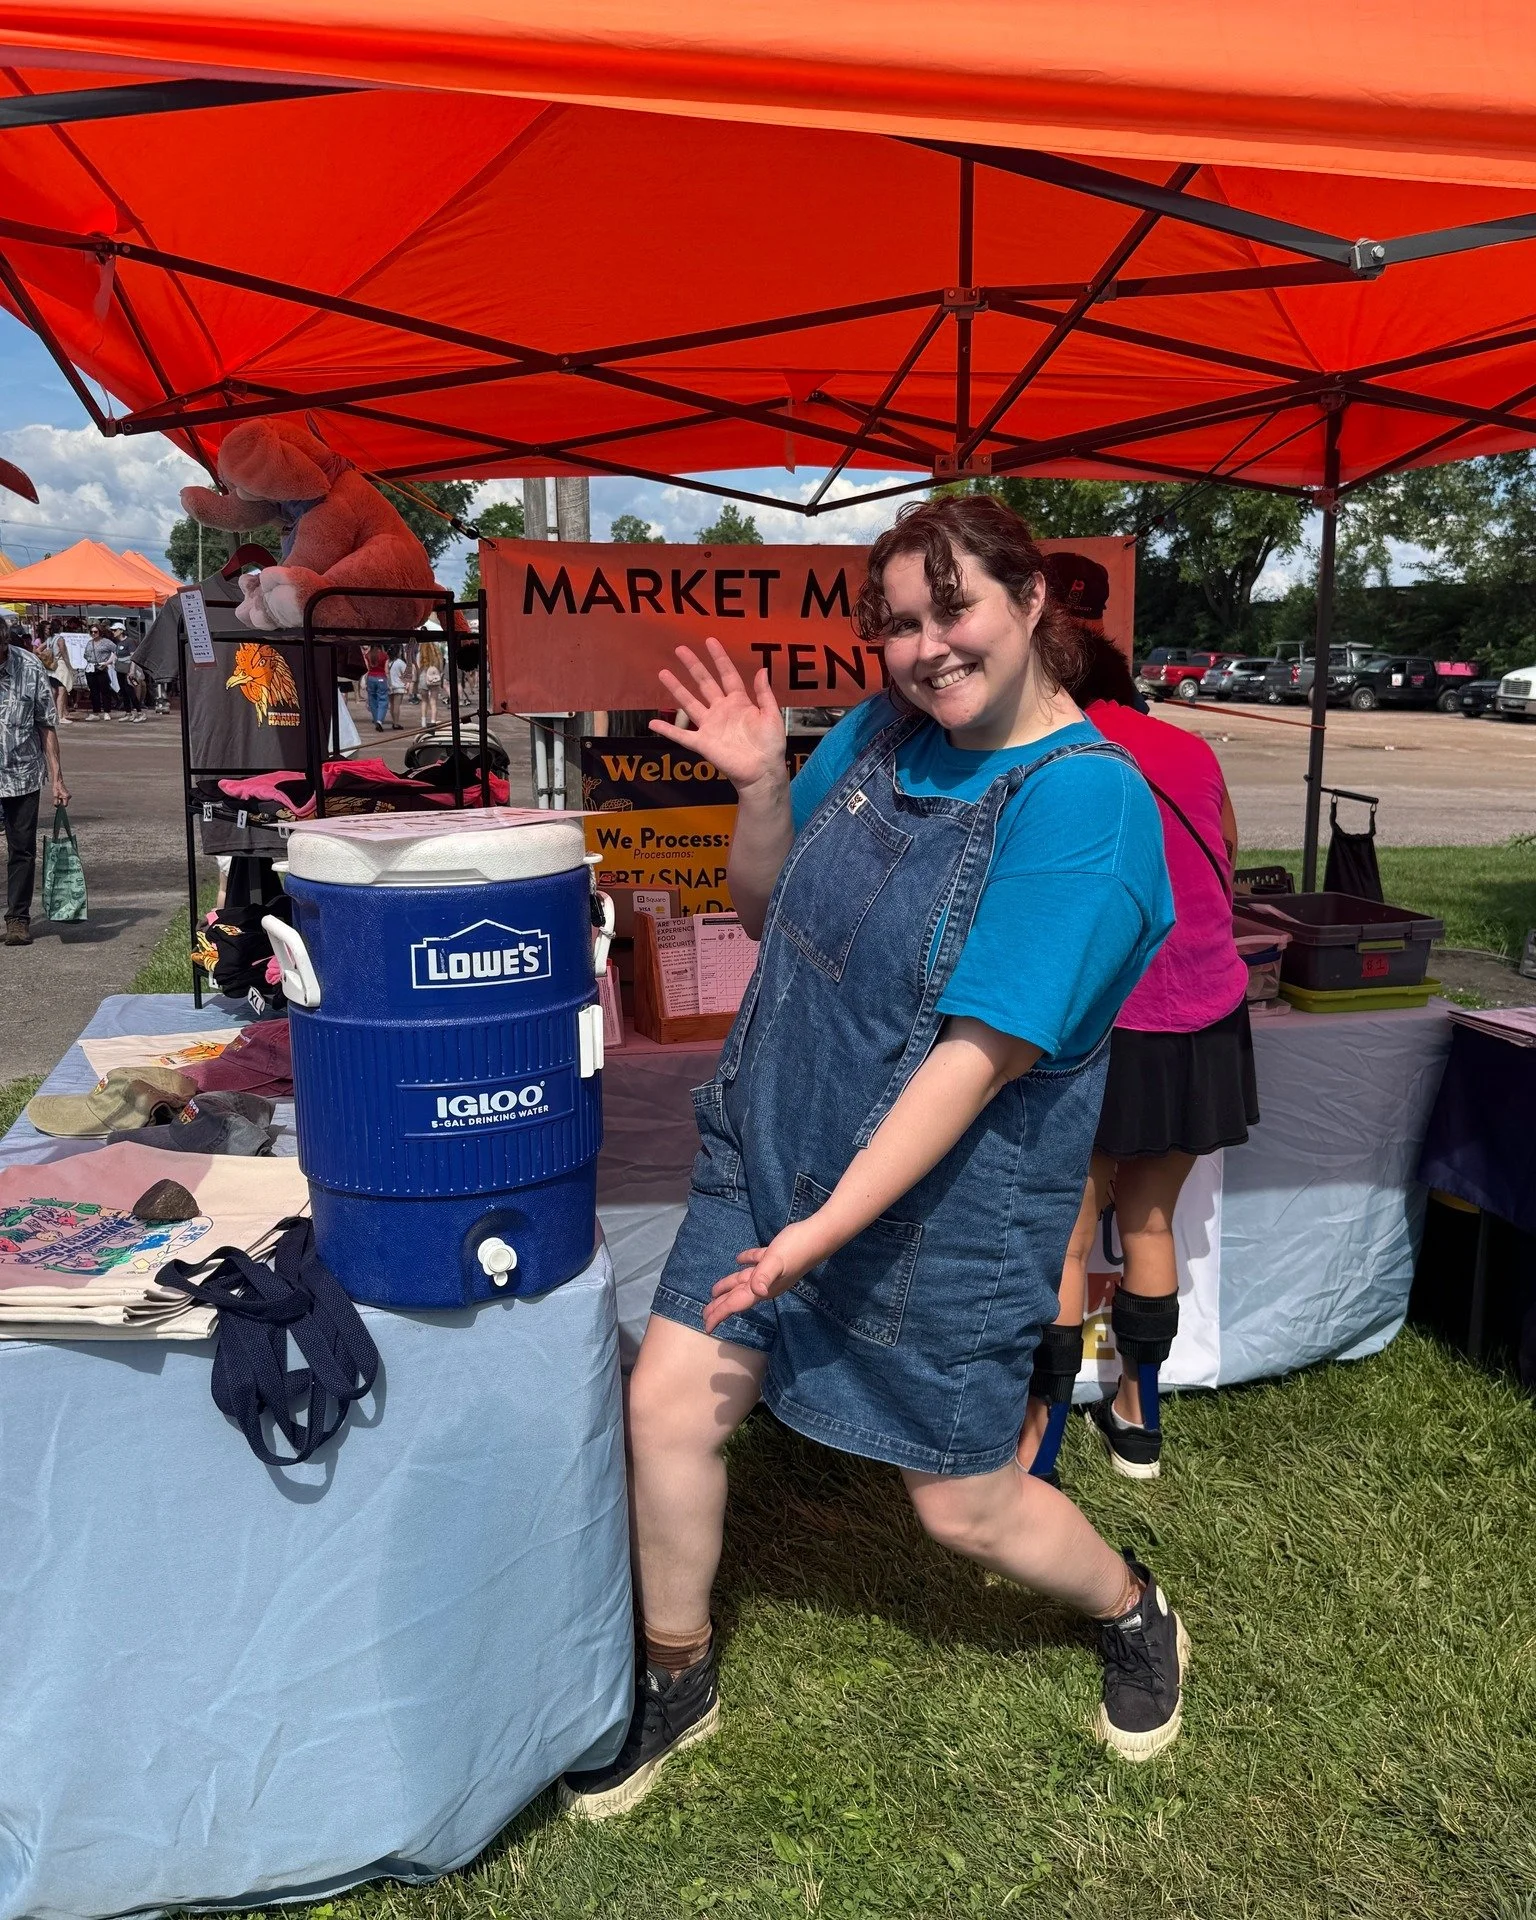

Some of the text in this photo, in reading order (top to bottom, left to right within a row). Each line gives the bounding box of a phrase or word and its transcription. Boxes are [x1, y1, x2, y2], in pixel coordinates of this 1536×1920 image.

[523, 563, 781, 619] MARKET
[751, 642, 890, 690] TENT
[596, 827, 729, 850] We Process:
[633, 848, 695, 860] Procesamos:
[658, 867, 727, 889] SNAP
[657, 920, 670, 928] ARE
[657, 934, 676, 943] FOOD
[428, 943, 540, 980] LOWE'S
[250, 990, 260, 1010] XL
[437, 1085, 543, 1119] IGLOO
[431, 1104, 549, 1129] 5-GAL DRINKING WATER
